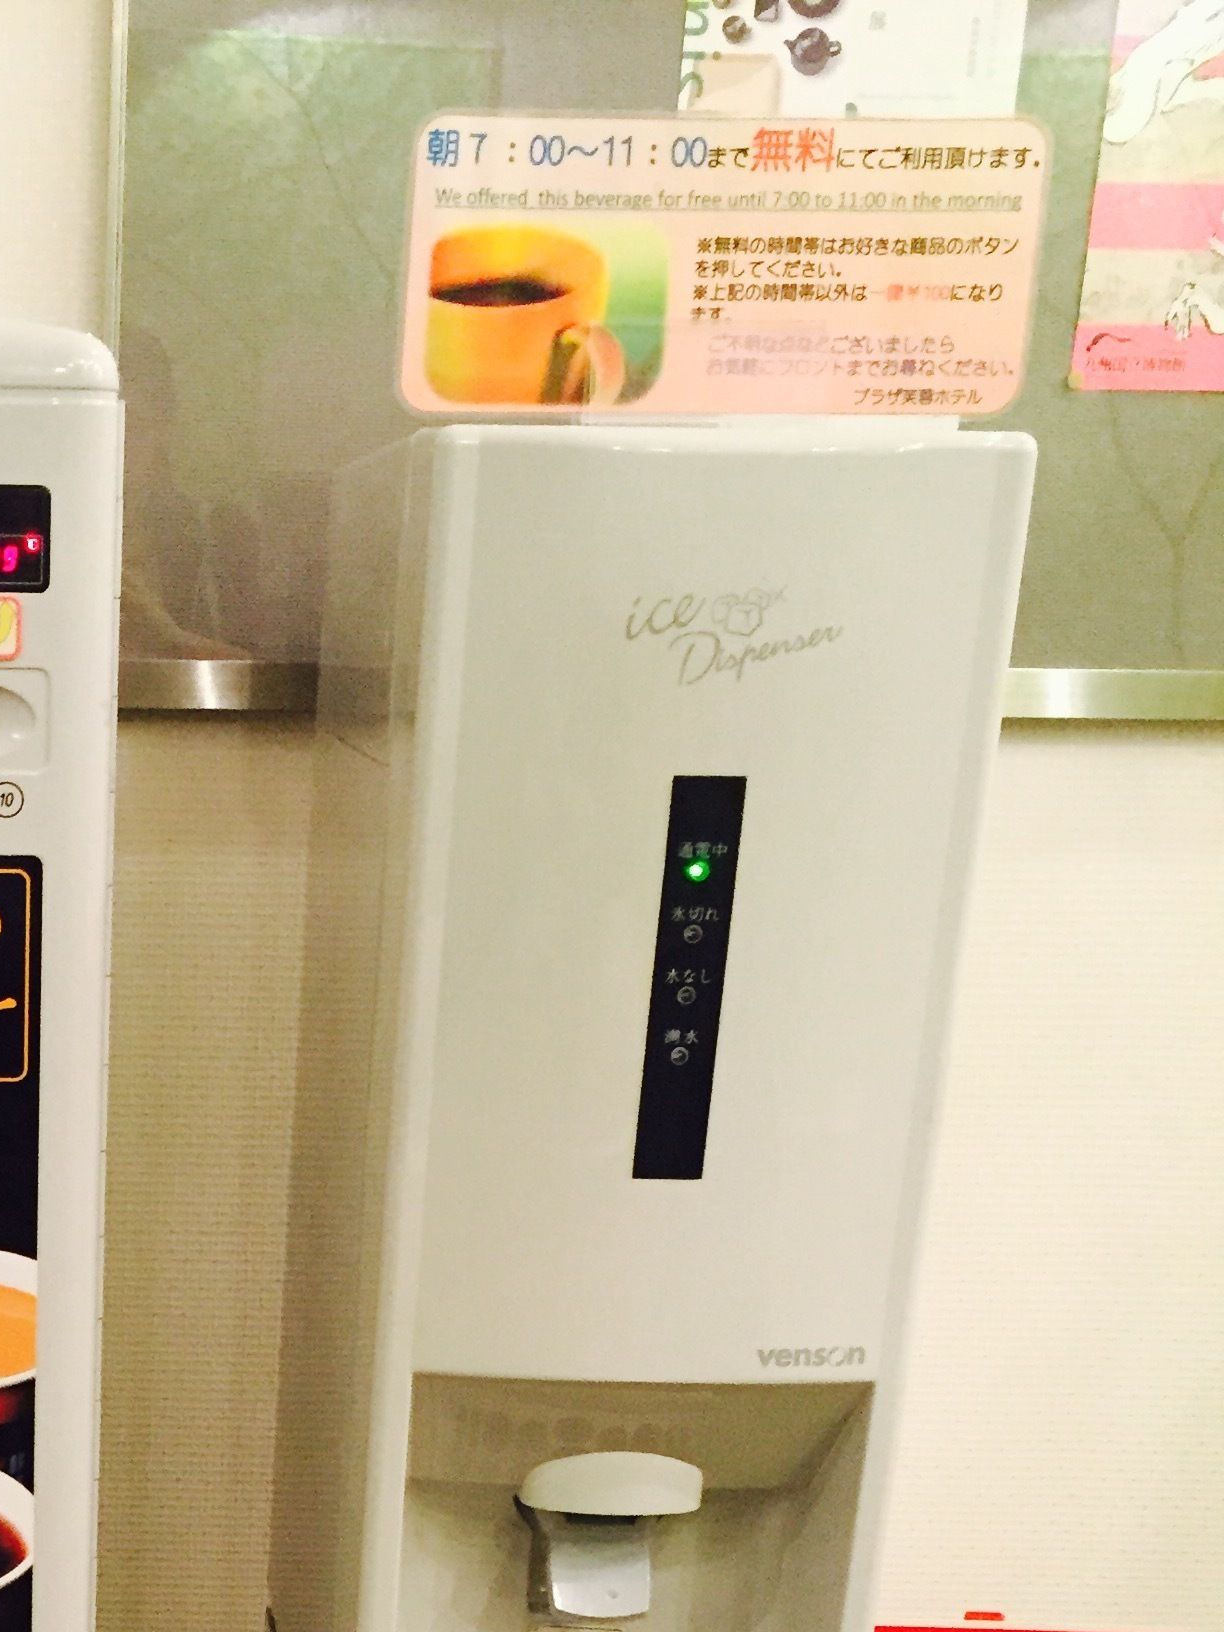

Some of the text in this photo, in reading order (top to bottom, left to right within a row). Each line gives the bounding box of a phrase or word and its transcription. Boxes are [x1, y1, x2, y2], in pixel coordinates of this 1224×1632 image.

[435, 187, 462, 207] We
[466, 187, 529, 208] offered
[538, 190, 569, 208] this
[574, 190, 652, 210] beverage
[657, 190, 683, 208] for
[687, 190, 722, 208] free
[727, 190, 767, 208] until
[816, 191, 832, 208] to
[839, 191, 887, 209] 11:00
[891, 191, 907, 209] in
[912, 191, 934, 209] the
[947, 191, 1023, 212] morning
[694, 259, 843, 278] を押してください。
[626, 594, 707, 641] ice
[670, 625, 844, 686] Dispenser
[0, 792, 15, 806] 10
[665, 968, 712, 984] 水なし
[756, 1346, 866, 1367] venson
